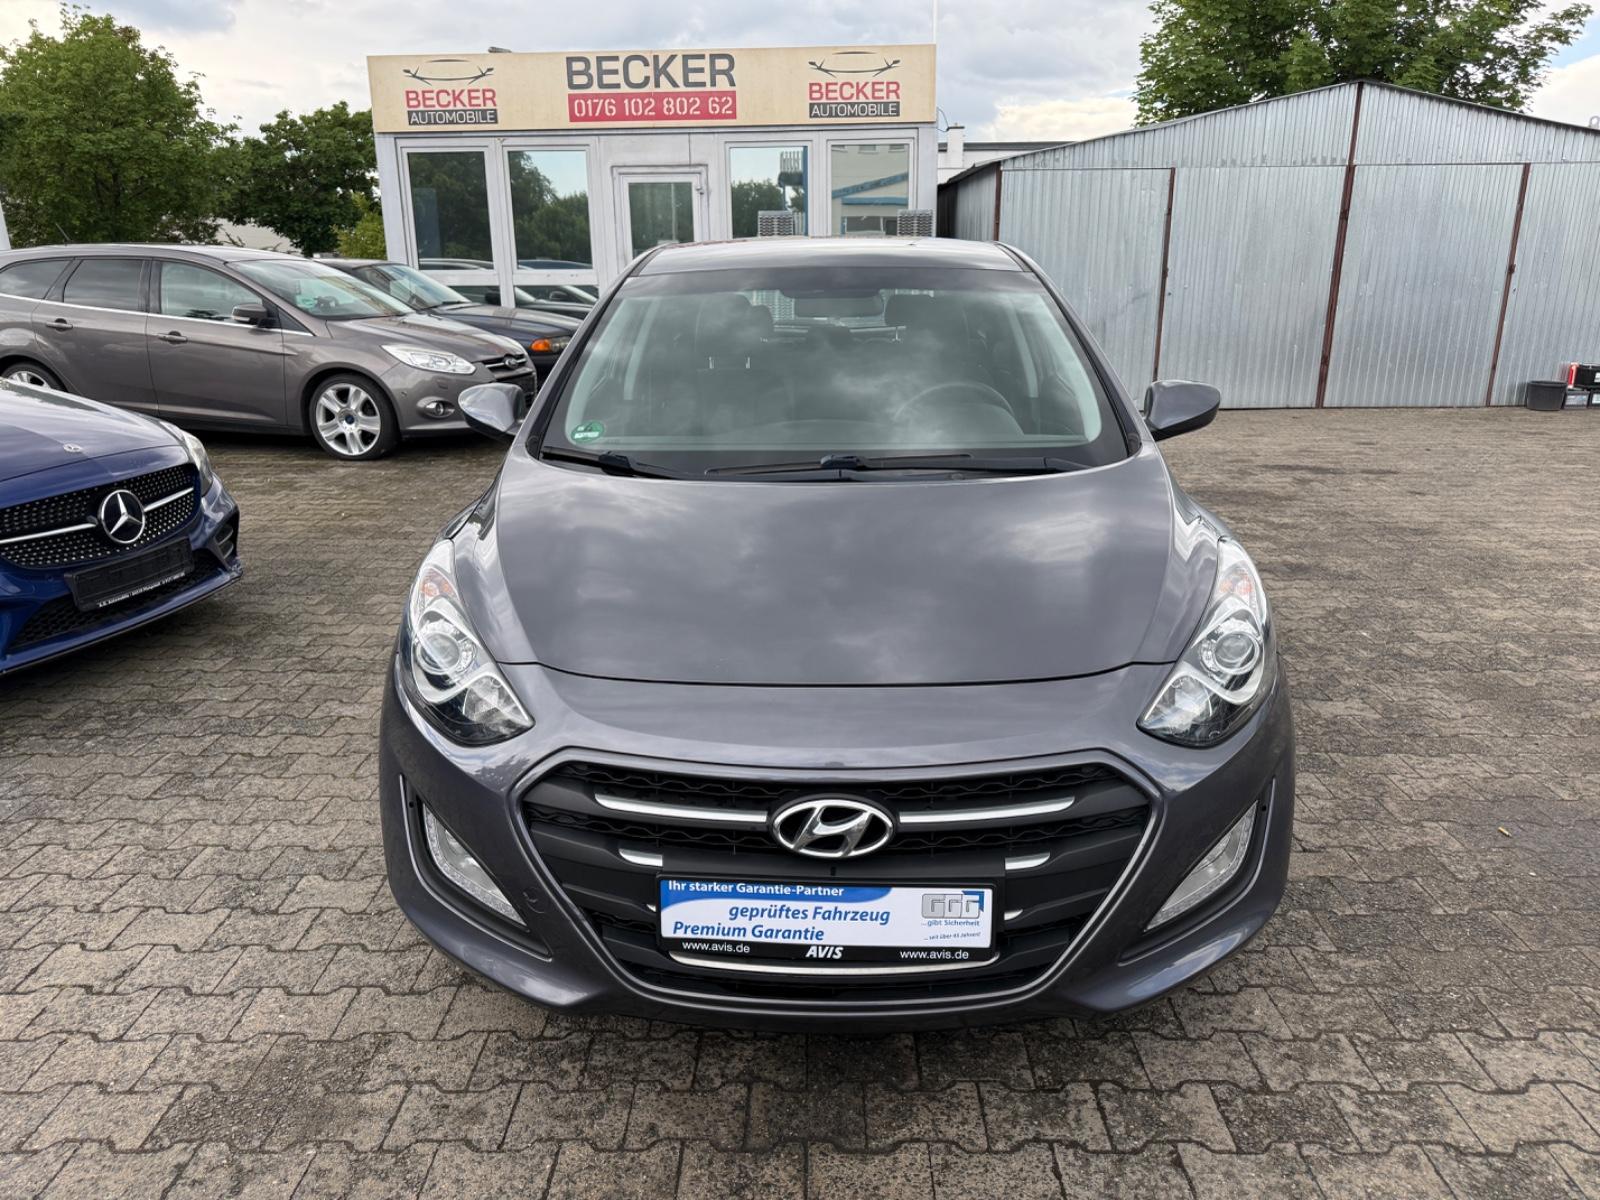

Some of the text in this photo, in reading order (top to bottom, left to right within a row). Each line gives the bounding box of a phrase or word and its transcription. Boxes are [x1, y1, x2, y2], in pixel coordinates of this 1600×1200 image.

[565, 53, 736, 90] BECKER
[405, 88, 497, 109] BECKER
[808, 81, 900, 101] BECKER
[574, 97, 733, 117] 0176 102 802 62
[811, 103, 897, 117] AUTOMOBILE
[409, 110, 496, 125] AUTOMOBILE
[668, 880, 844, 897] Ihr starker Garantie-Partner
[728, 904, 891, 925] geprüftes Fahrzeug
[673, 921, 825, 941] Premium Garantie
[682, 942, 750, 954] www.avis.de
[805, 945, 844, 959] AVIS
[900, 950, 969, 960] www.avis.de
